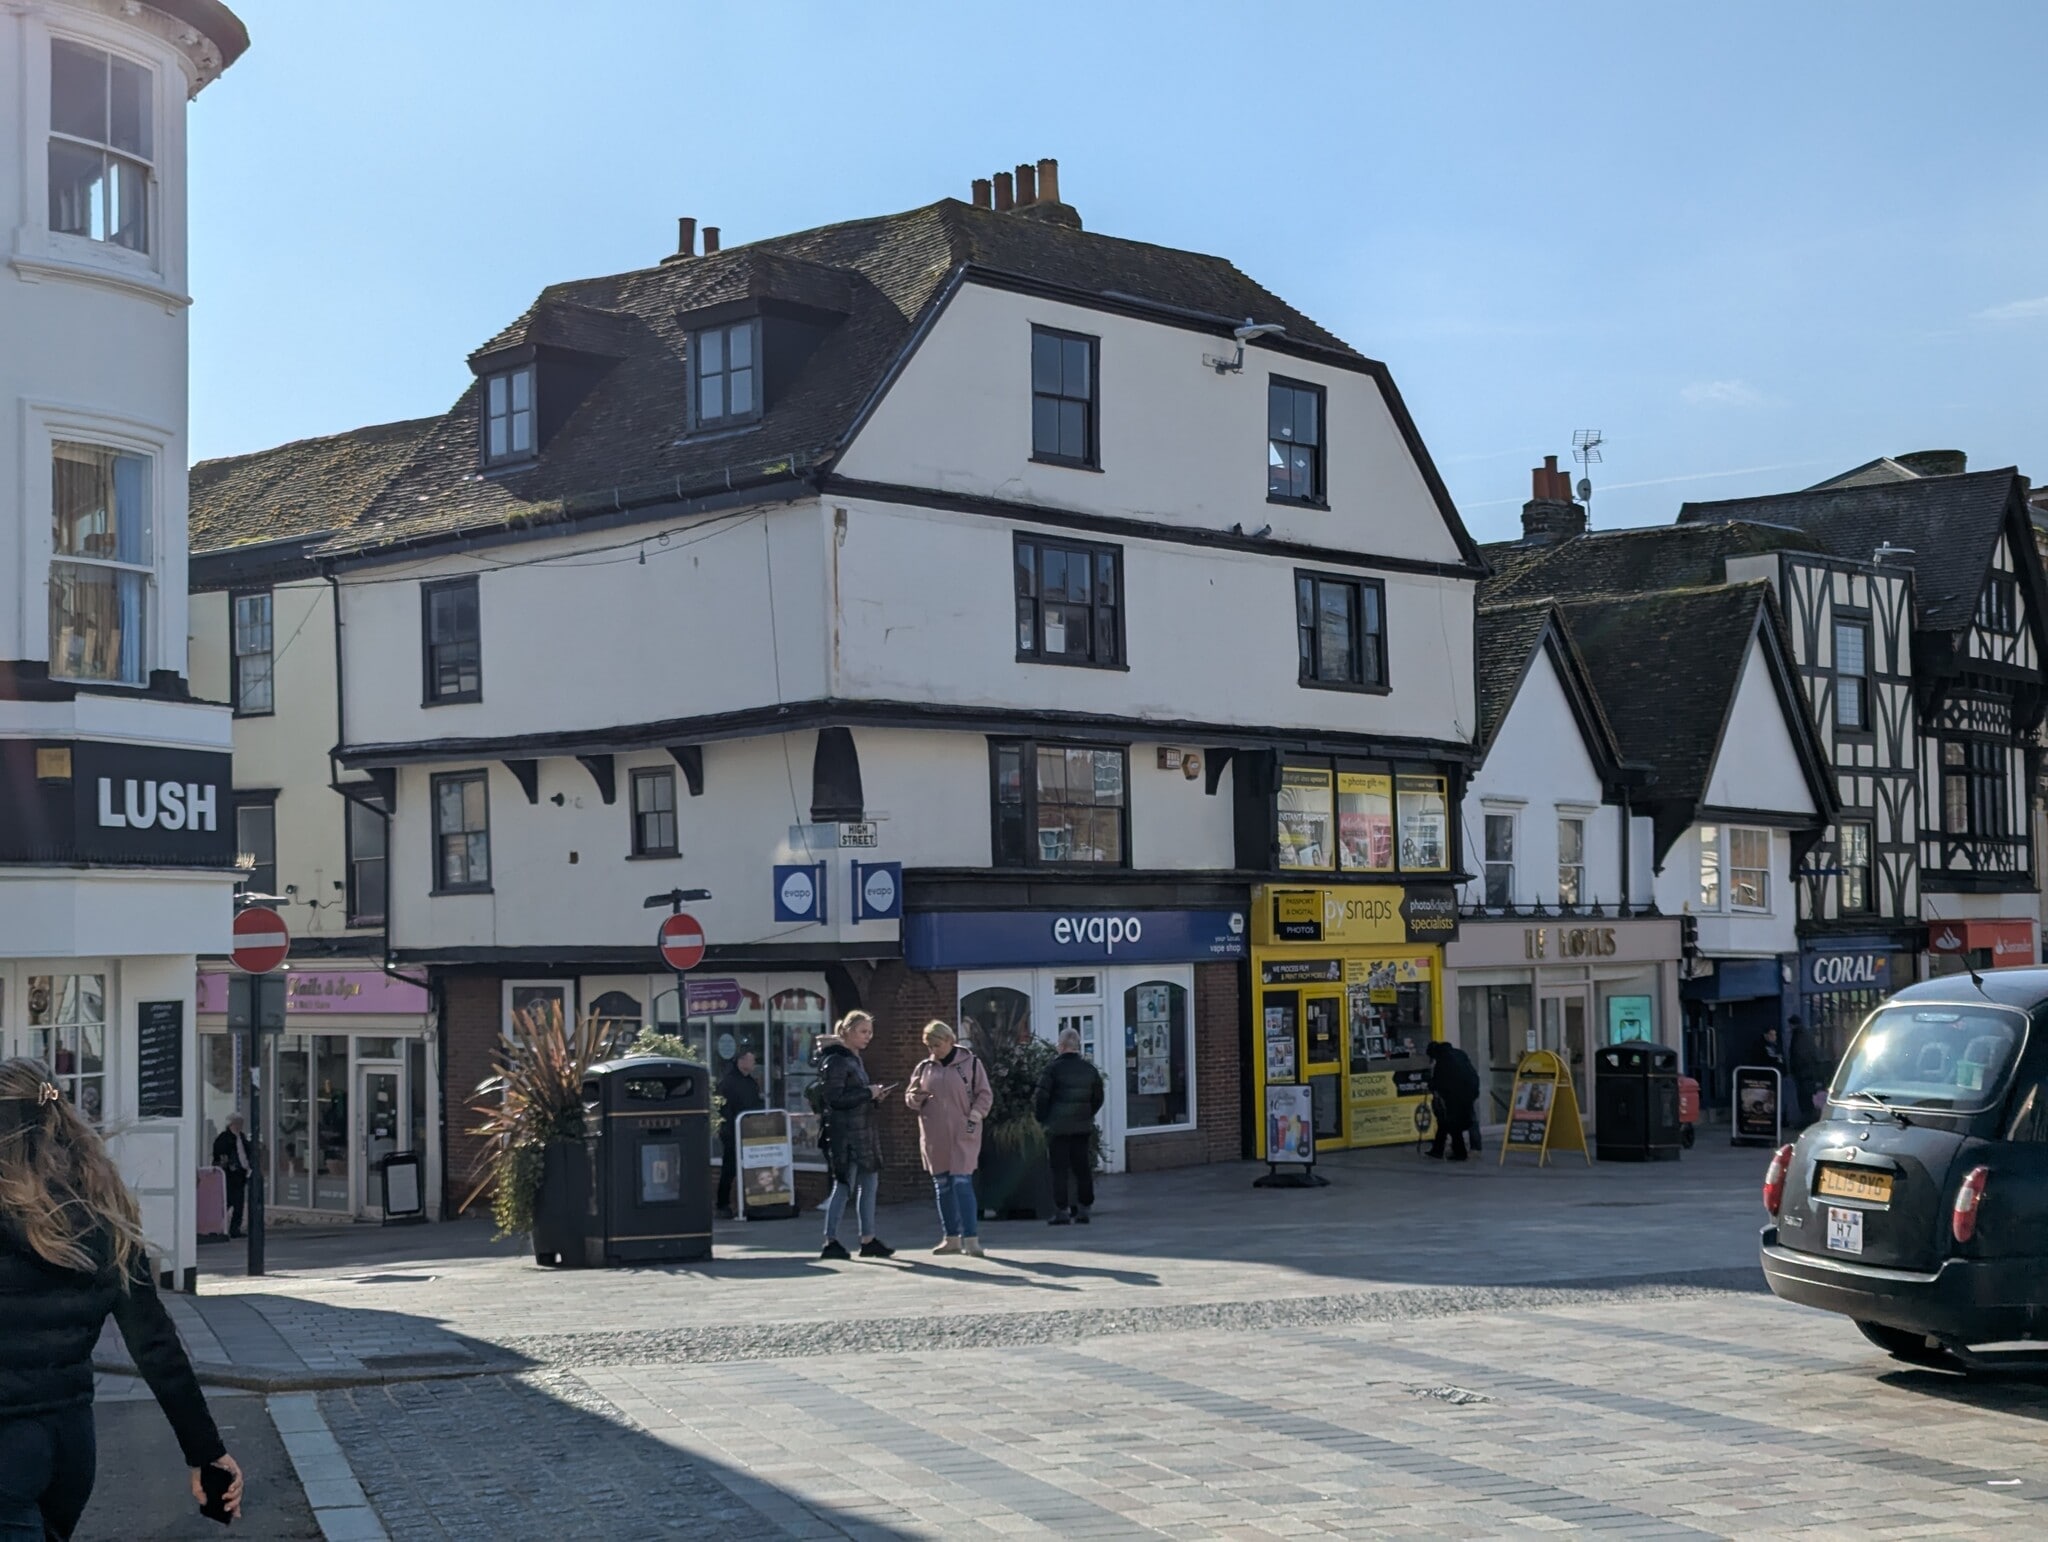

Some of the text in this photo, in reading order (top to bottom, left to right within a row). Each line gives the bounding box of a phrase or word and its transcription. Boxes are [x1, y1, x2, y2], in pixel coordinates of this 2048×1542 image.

[98, 777, 217, 831] LUSH
[848, 824, 868, 835] HIGH
[841, 835, 874, 846] STREET
[784, 889, 811, 900] evapo
[867, 887, 893, 898] evapo
[1285, 897, 1314, 905] PASSPORT
[1292, 908, 1315, 916] DIGITAL
[1287, 926, 1315, 934] PHOTOS
[1410, 915, 1454, 934] specialists
[1054, 916, 1142, 954] evapo
[1210, 943, 1241, 954] vape shop
[1813, 955, 1876, 984] CORAL
